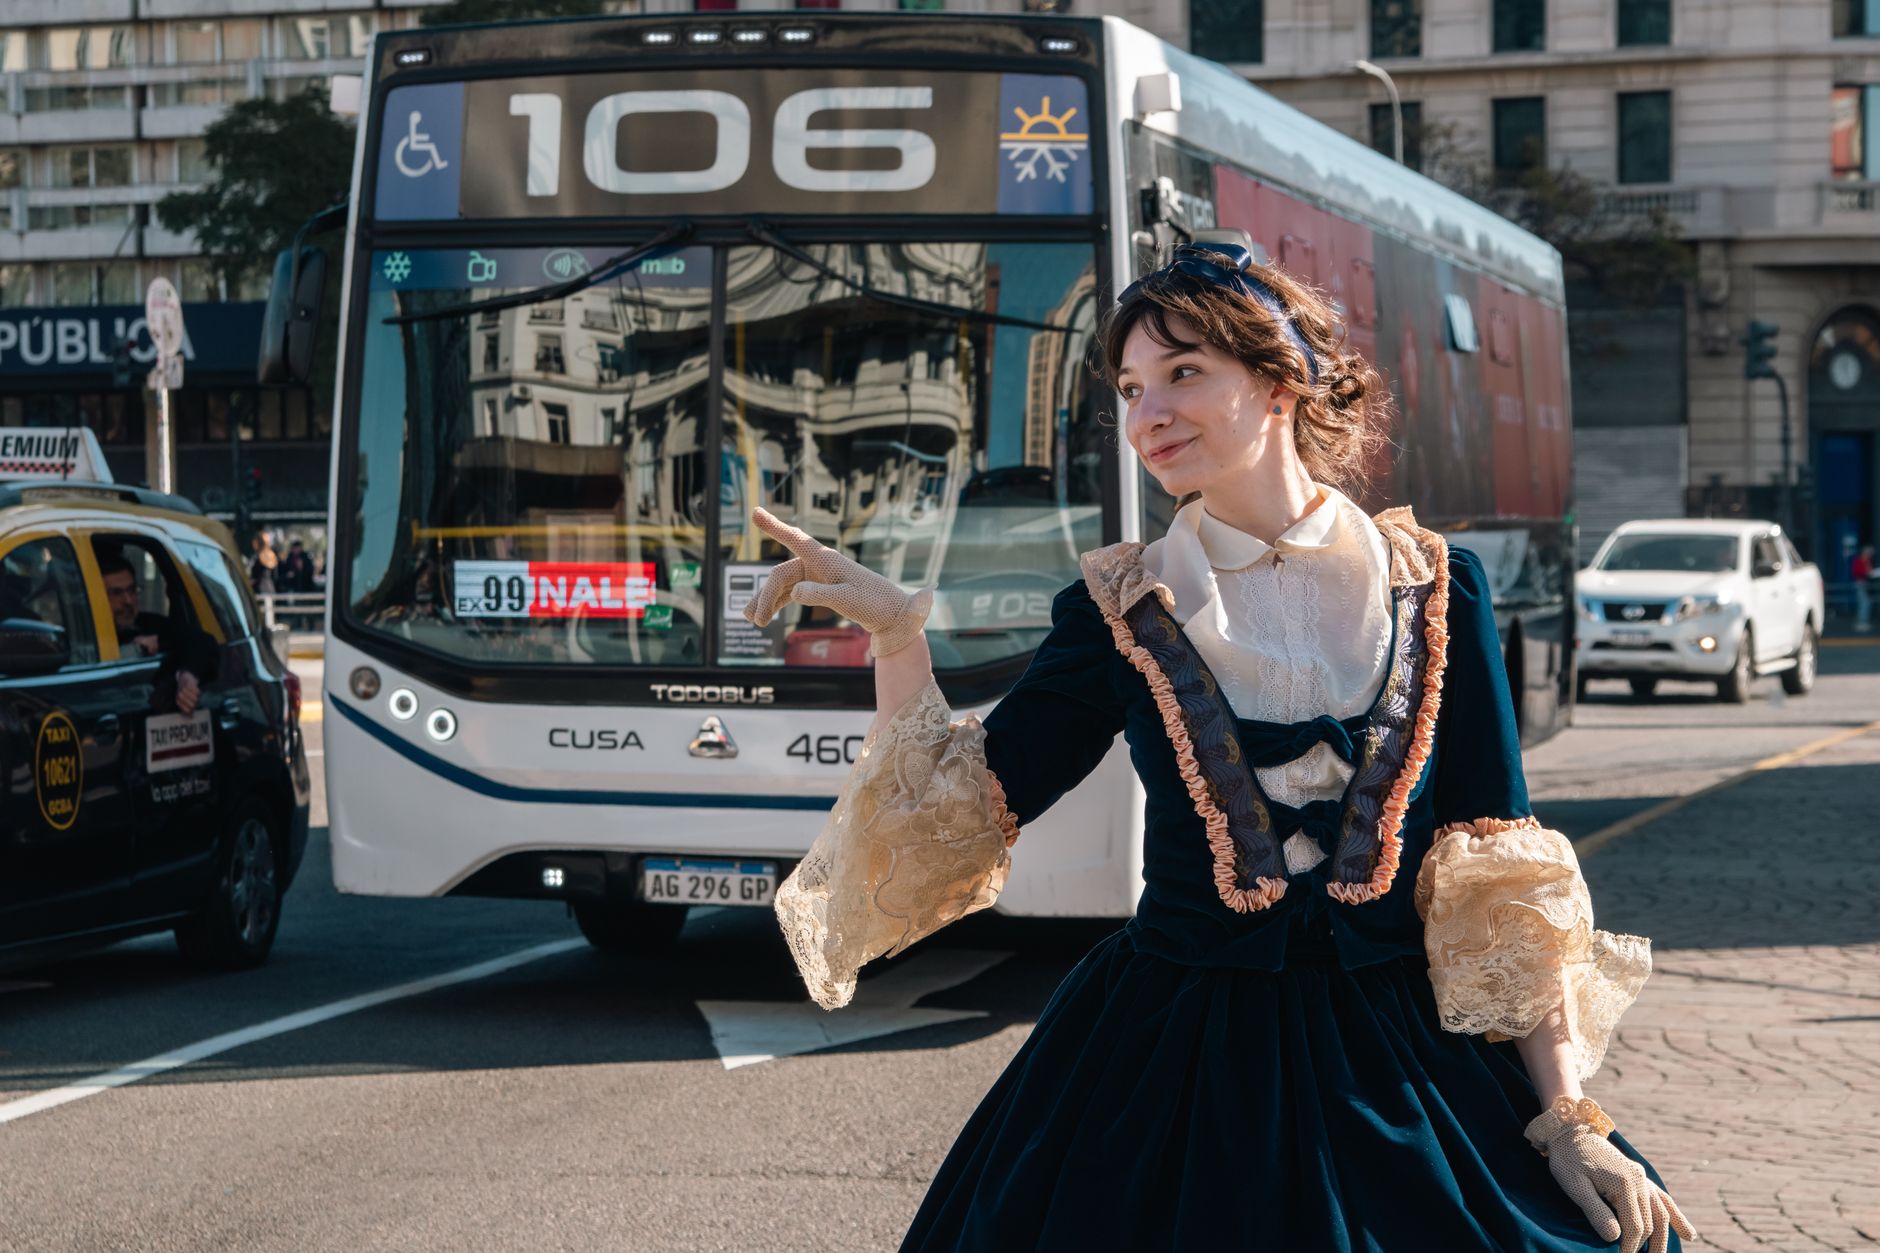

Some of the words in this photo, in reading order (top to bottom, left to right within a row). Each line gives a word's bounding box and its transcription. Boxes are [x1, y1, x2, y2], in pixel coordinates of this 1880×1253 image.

[509, 86, 937, 197] 106
[484, 575, 526, 612] 99
[528, 576, 657, 609] NALE
[650, 684, 775, 703] TODOBUS
[45, 727, 71, 744] TAXI
[549, 727, 645, 750] CUSA
[652, 874, 679, 898] AG
[688, 875, 731, 899] 296
[740, 877, 769, 901] GP
